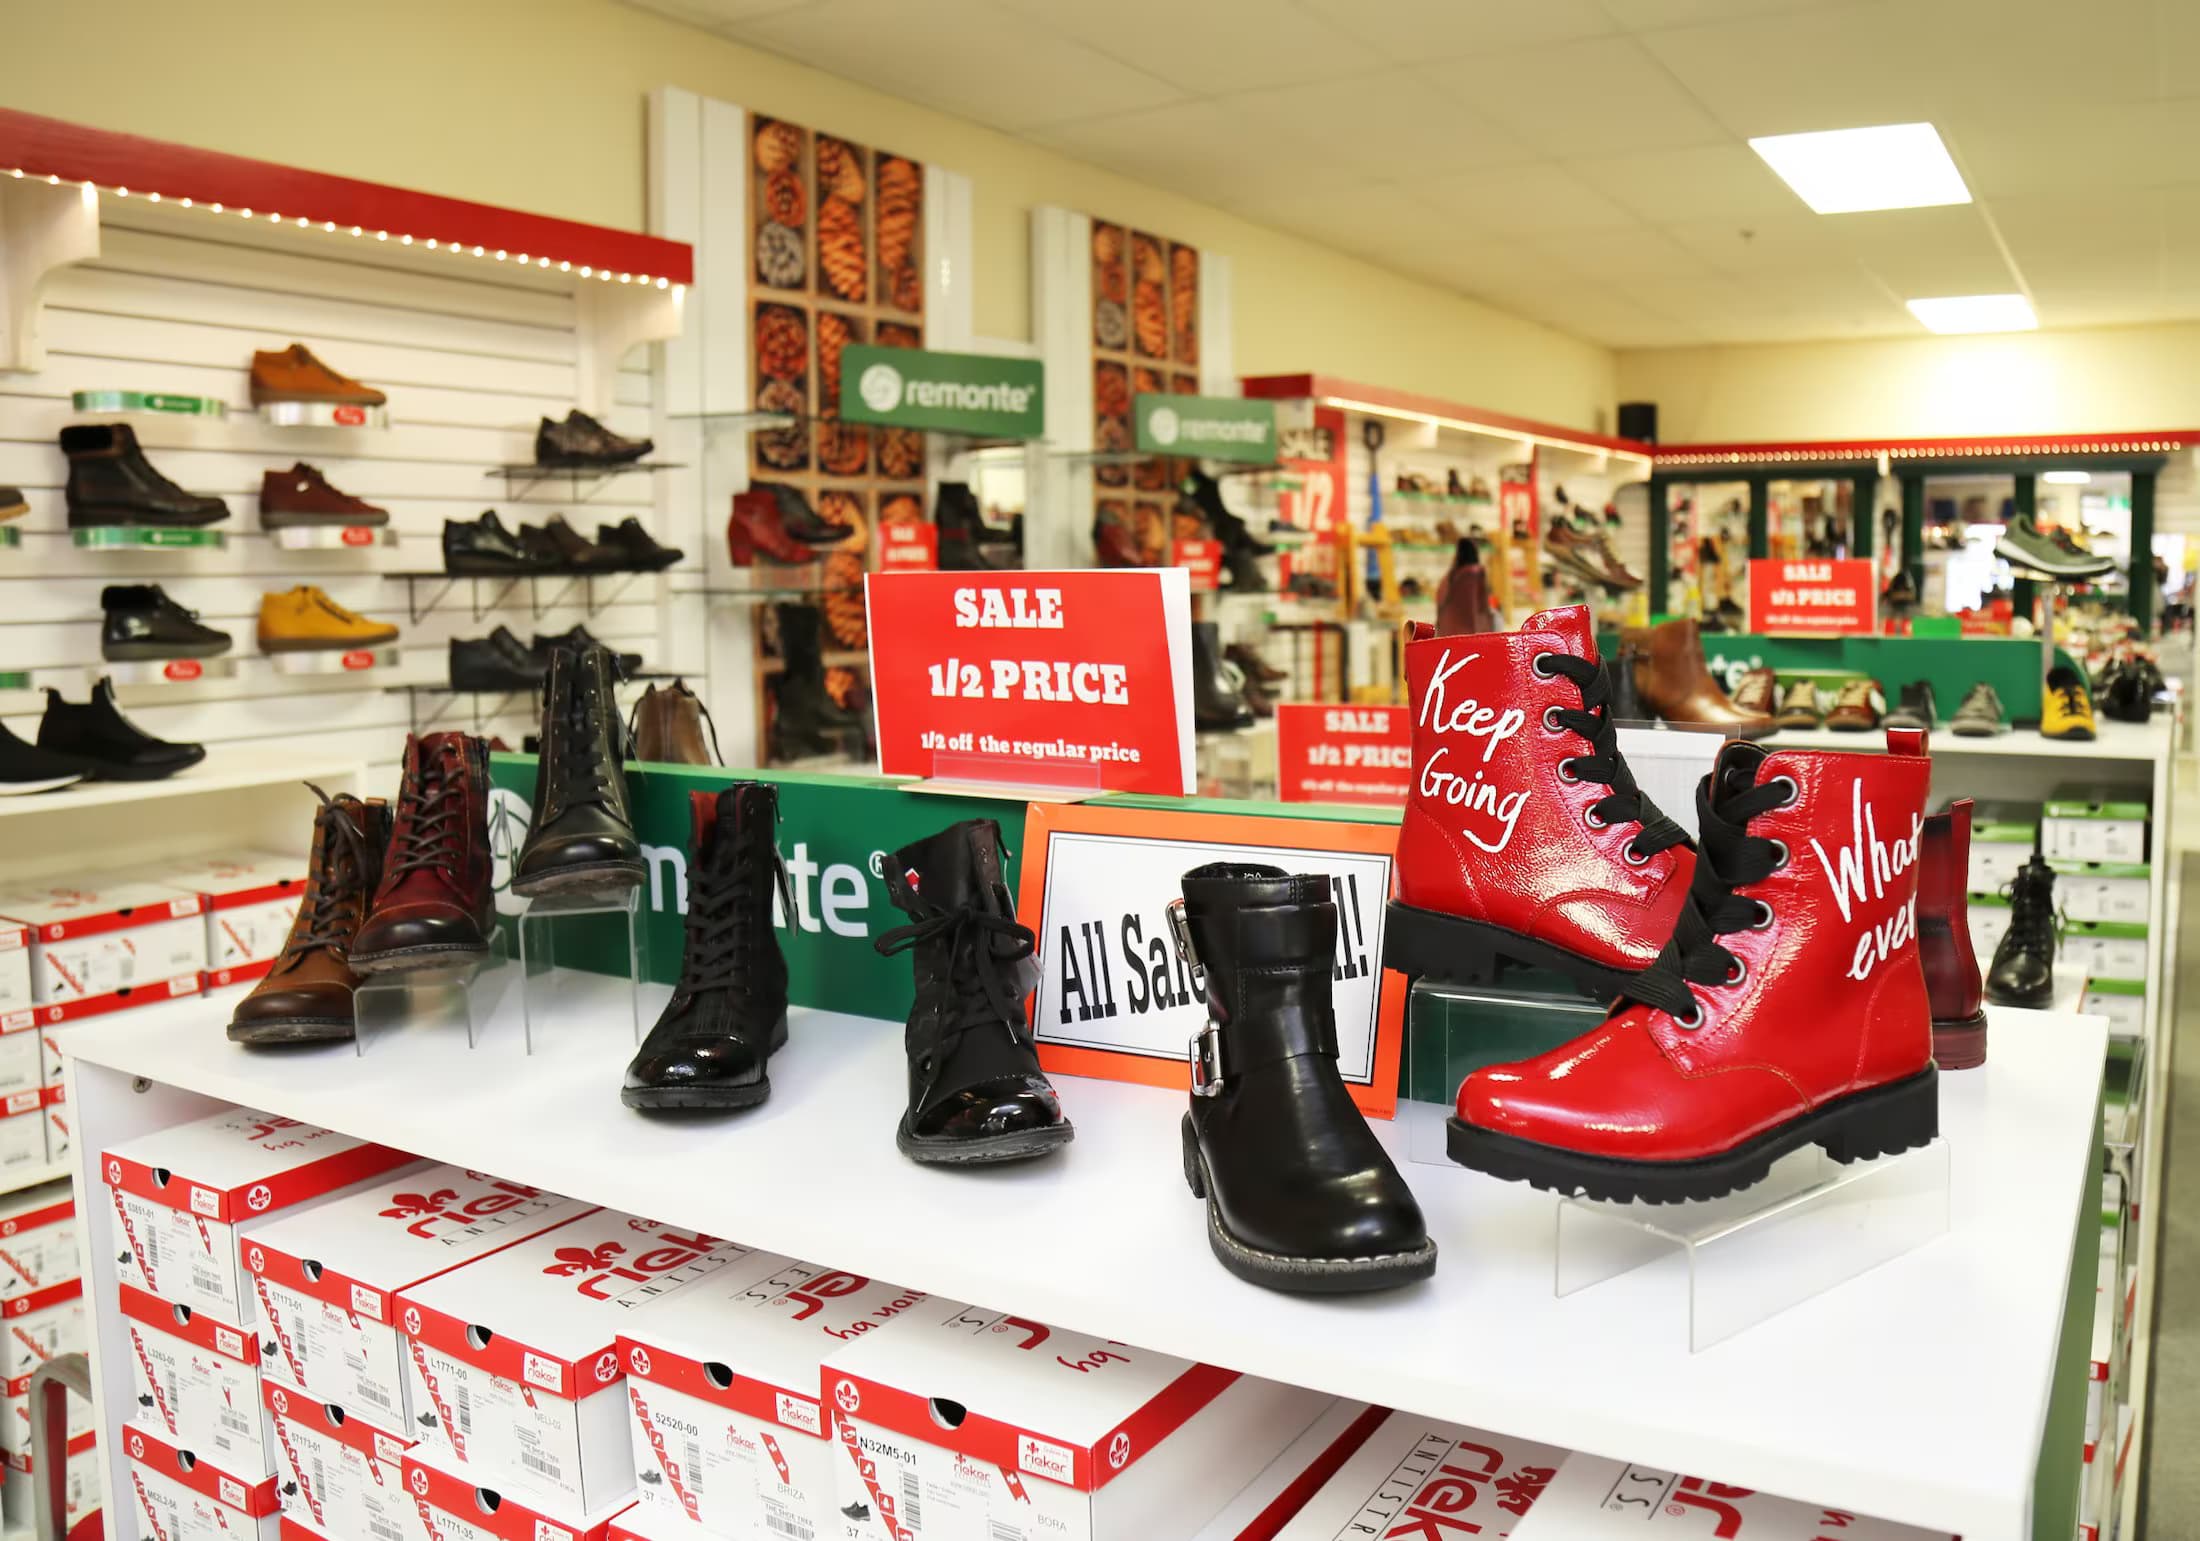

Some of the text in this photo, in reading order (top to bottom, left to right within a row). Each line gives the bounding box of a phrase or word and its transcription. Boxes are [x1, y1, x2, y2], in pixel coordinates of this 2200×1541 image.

[954, 588, 1064, 629] SALE
[928, 658, 1129, 705] 1/2 PRICE
[1419, 649, 1525, 762] Keep
[1324, 710, 1390, 734] SALE
[921, 731, 1141, 763] 1/2 off the regular price
[1420, 747, 1531, 853] Going
[1809, 777, 1925, 923] What
[1060, 920, 1117, 1024] All
[430, 1357, 468, 1381] L1771-00
[655, 1412, 698, 1437] 52520-00
[781, 1407, 815, 1426] rieker
[859, 1436, 917, 1466] N32M5-01
[1024, 1453, 1067, 1473] rieker
[953, 1462, 990, 1482] rieker
[643, 1489, 655, 1502] 37
[435, 1514, 474, 1541] L1771-35
[845, 1525, 860, 1540] 37
[1037, 1513, 1068, 1532] BORA
